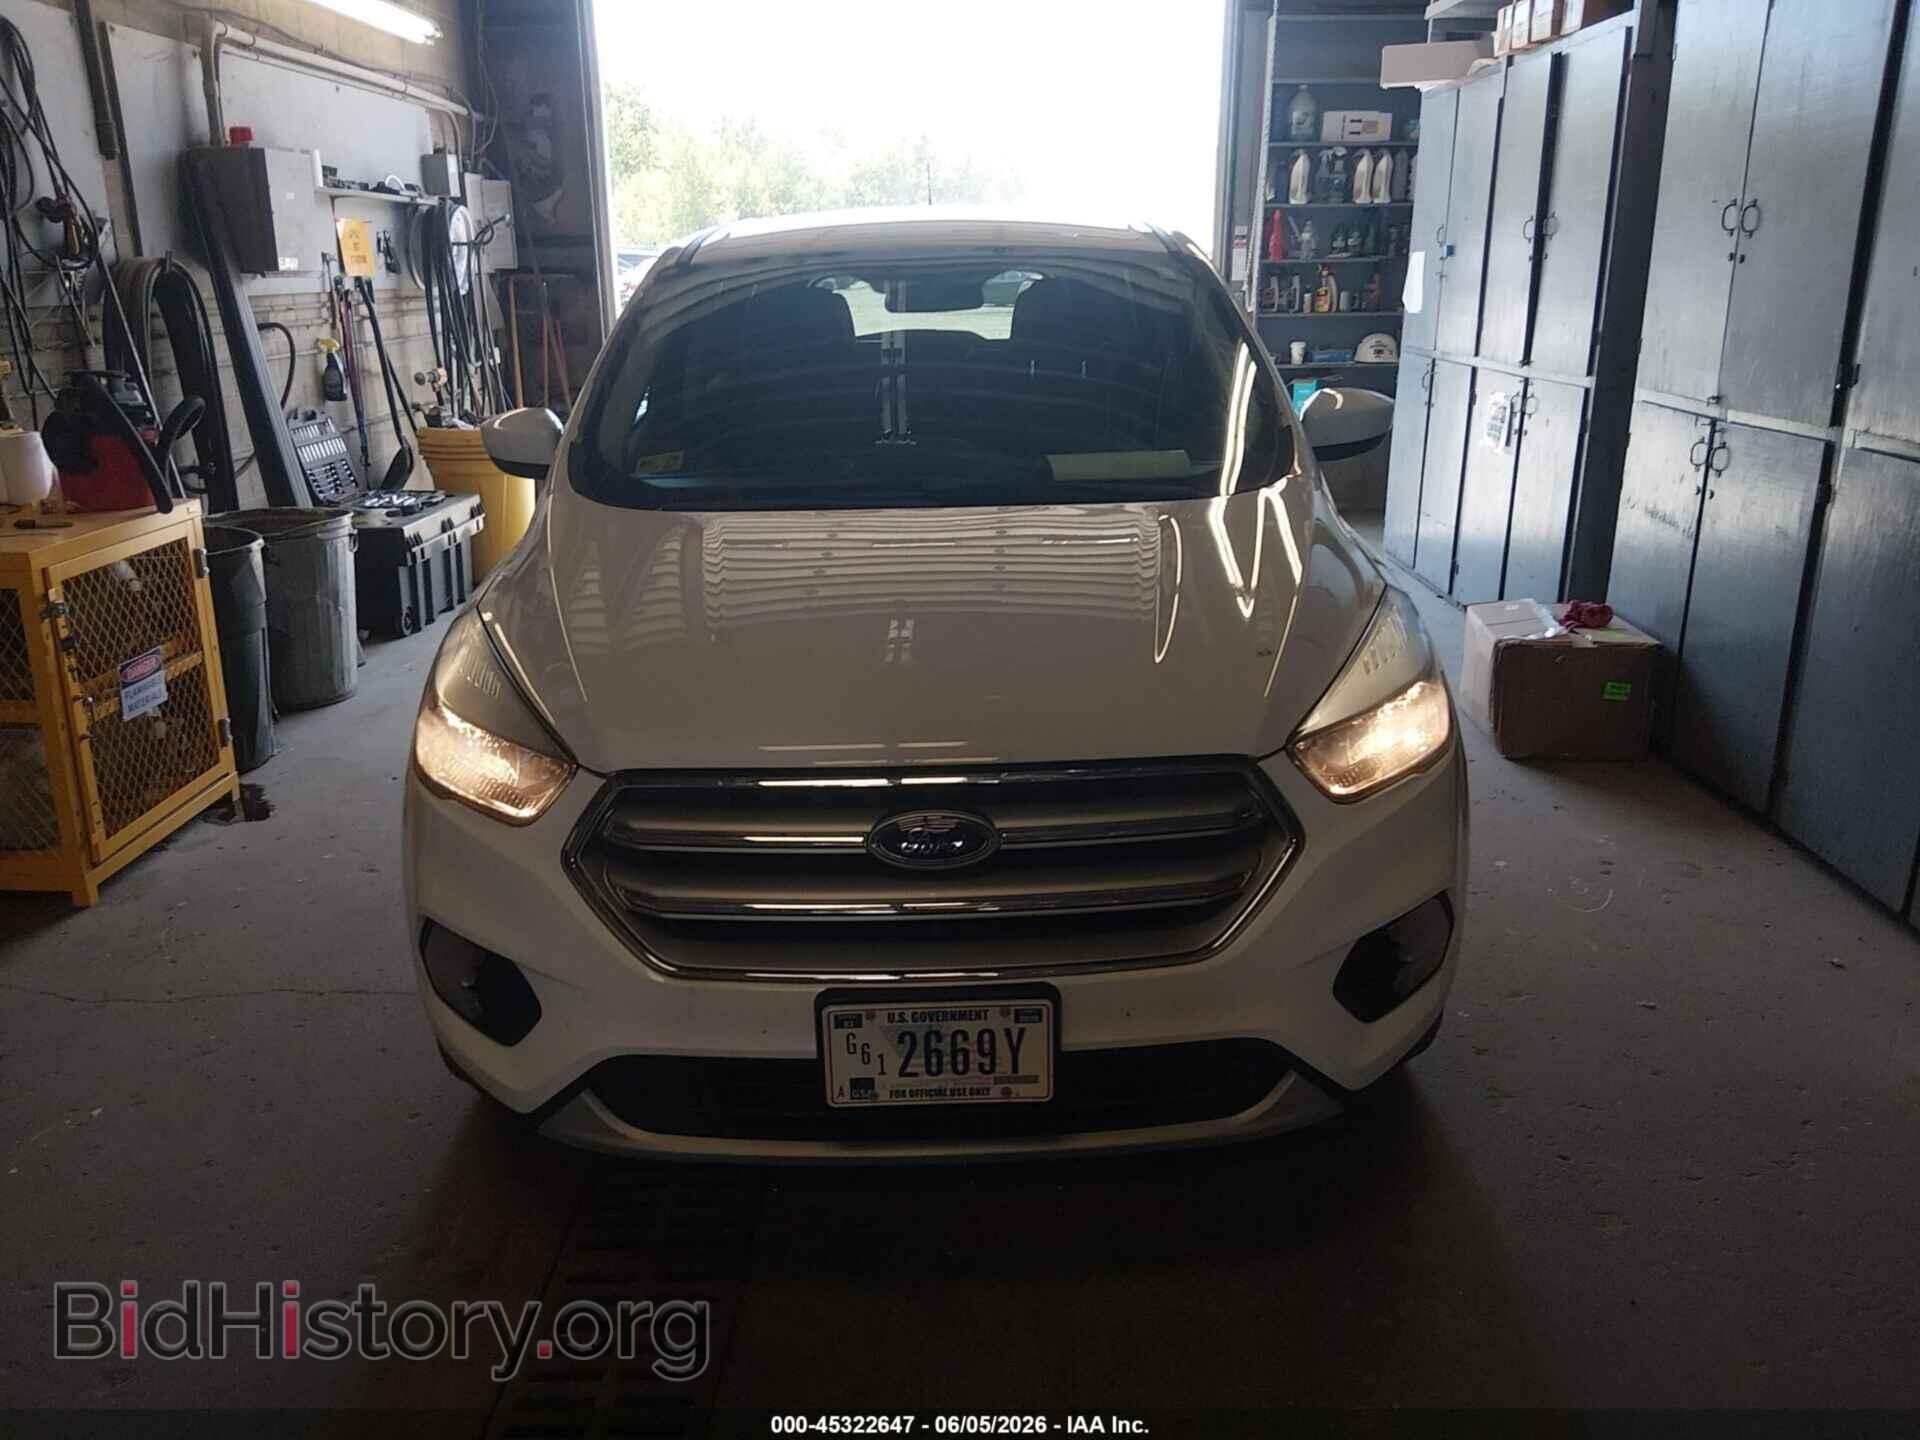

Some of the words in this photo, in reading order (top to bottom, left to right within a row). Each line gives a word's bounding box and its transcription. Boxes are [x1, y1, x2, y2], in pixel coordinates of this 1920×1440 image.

[887, 1011, 909, 1023] U.S.
[911, 1009, 990, 1022] GOVERNMENT
[898, 1027, 1026, 1077] 2669Y
[889, 1090, 906, 1099] FOR
[908, 1088, 947, 1098] OFFICIAL
[949, 1088, 968, 1098] USE
[969, 1087, 991, 1097] ONLY
